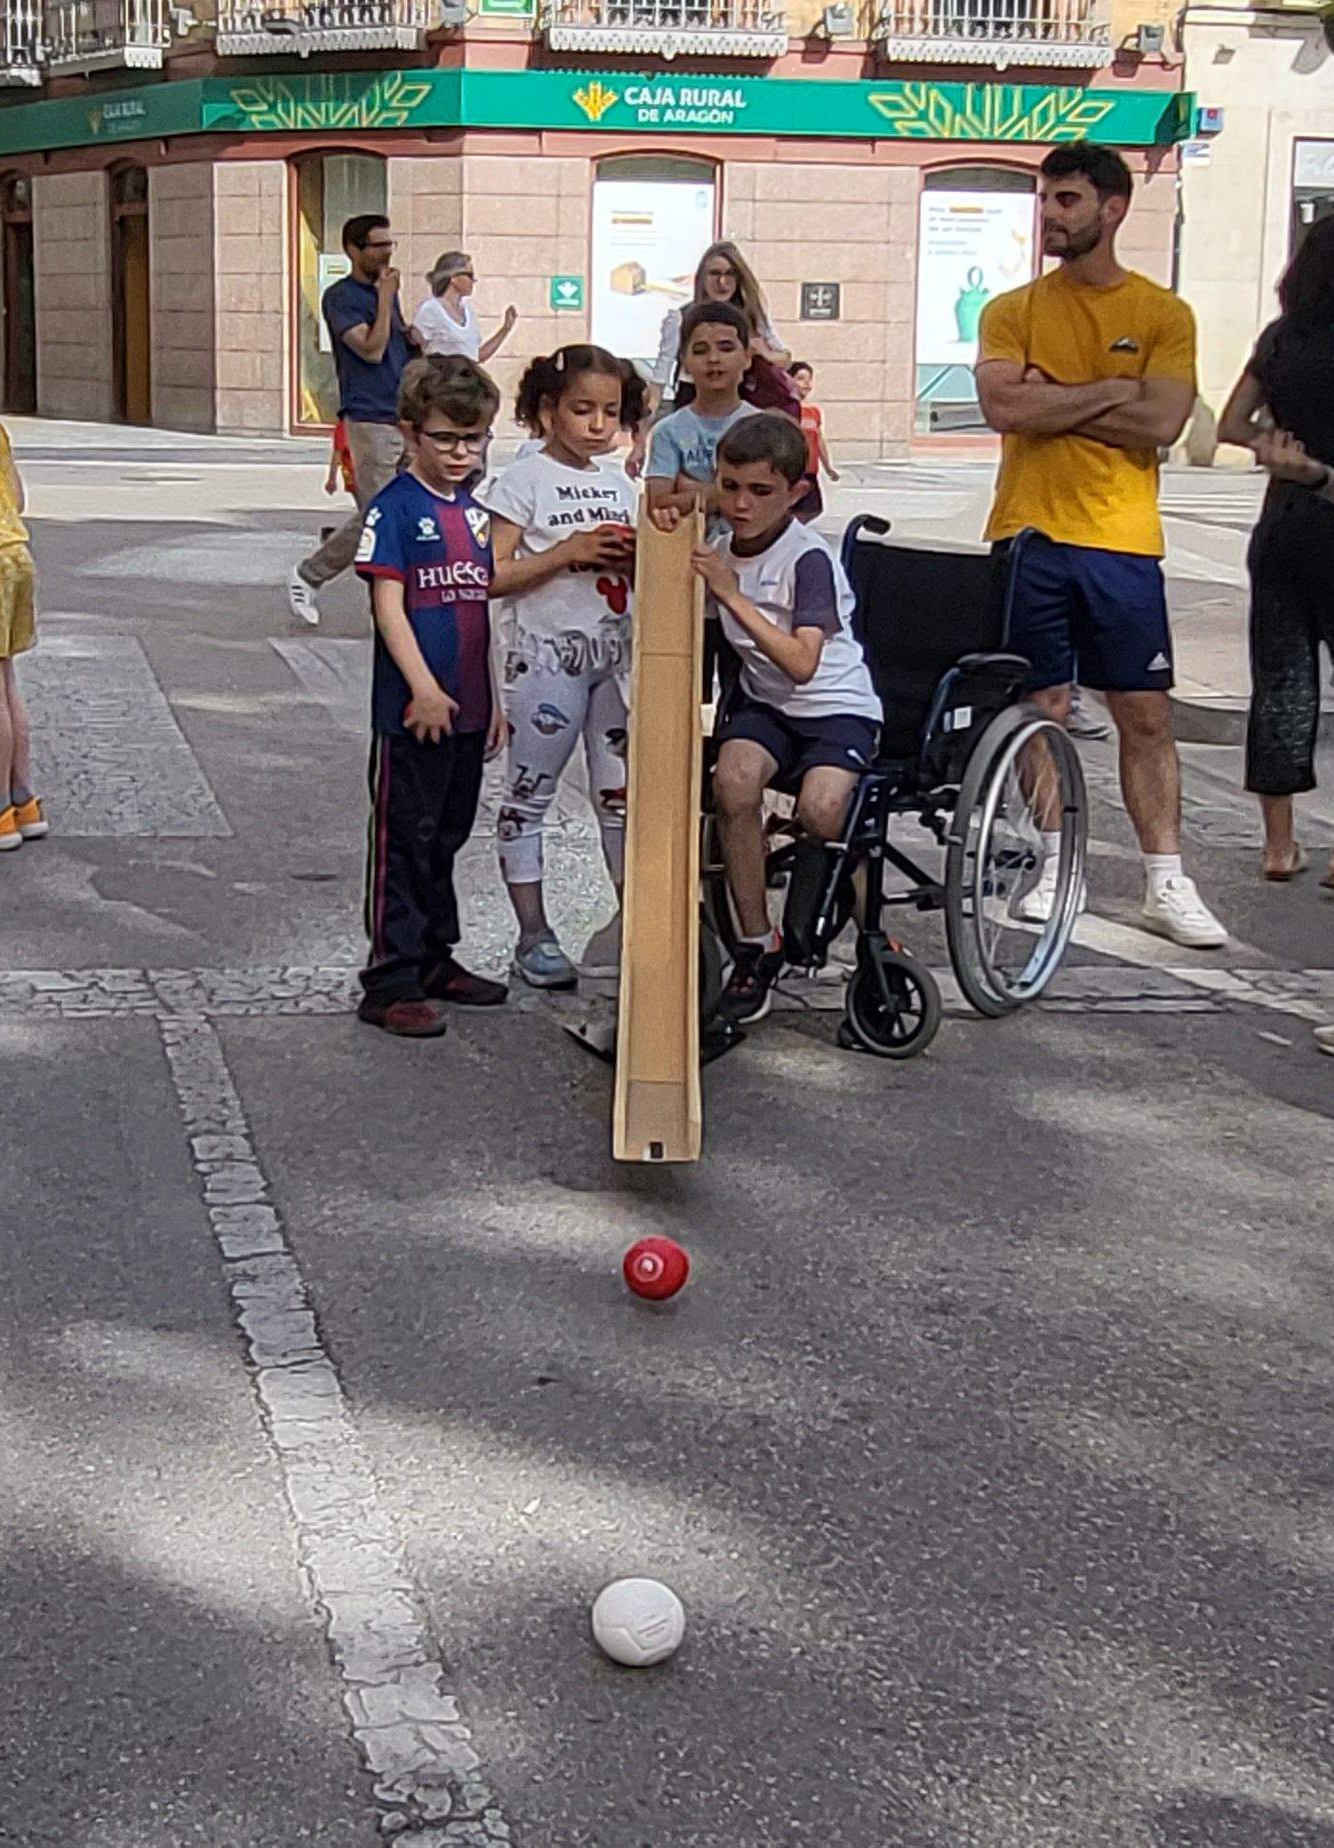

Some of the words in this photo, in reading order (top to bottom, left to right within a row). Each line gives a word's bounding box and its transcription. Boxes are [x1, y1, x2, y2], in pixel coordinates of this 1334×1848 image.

[624, 87, 675, 106] CAJA
[680, 89, 746, 107] RURAL
[637, 108, 659, 122] DE
[555, 485, 618, 502] Mickey
[548, 508, 585, 527] and
[417, 560, 489, 588] HUESC
